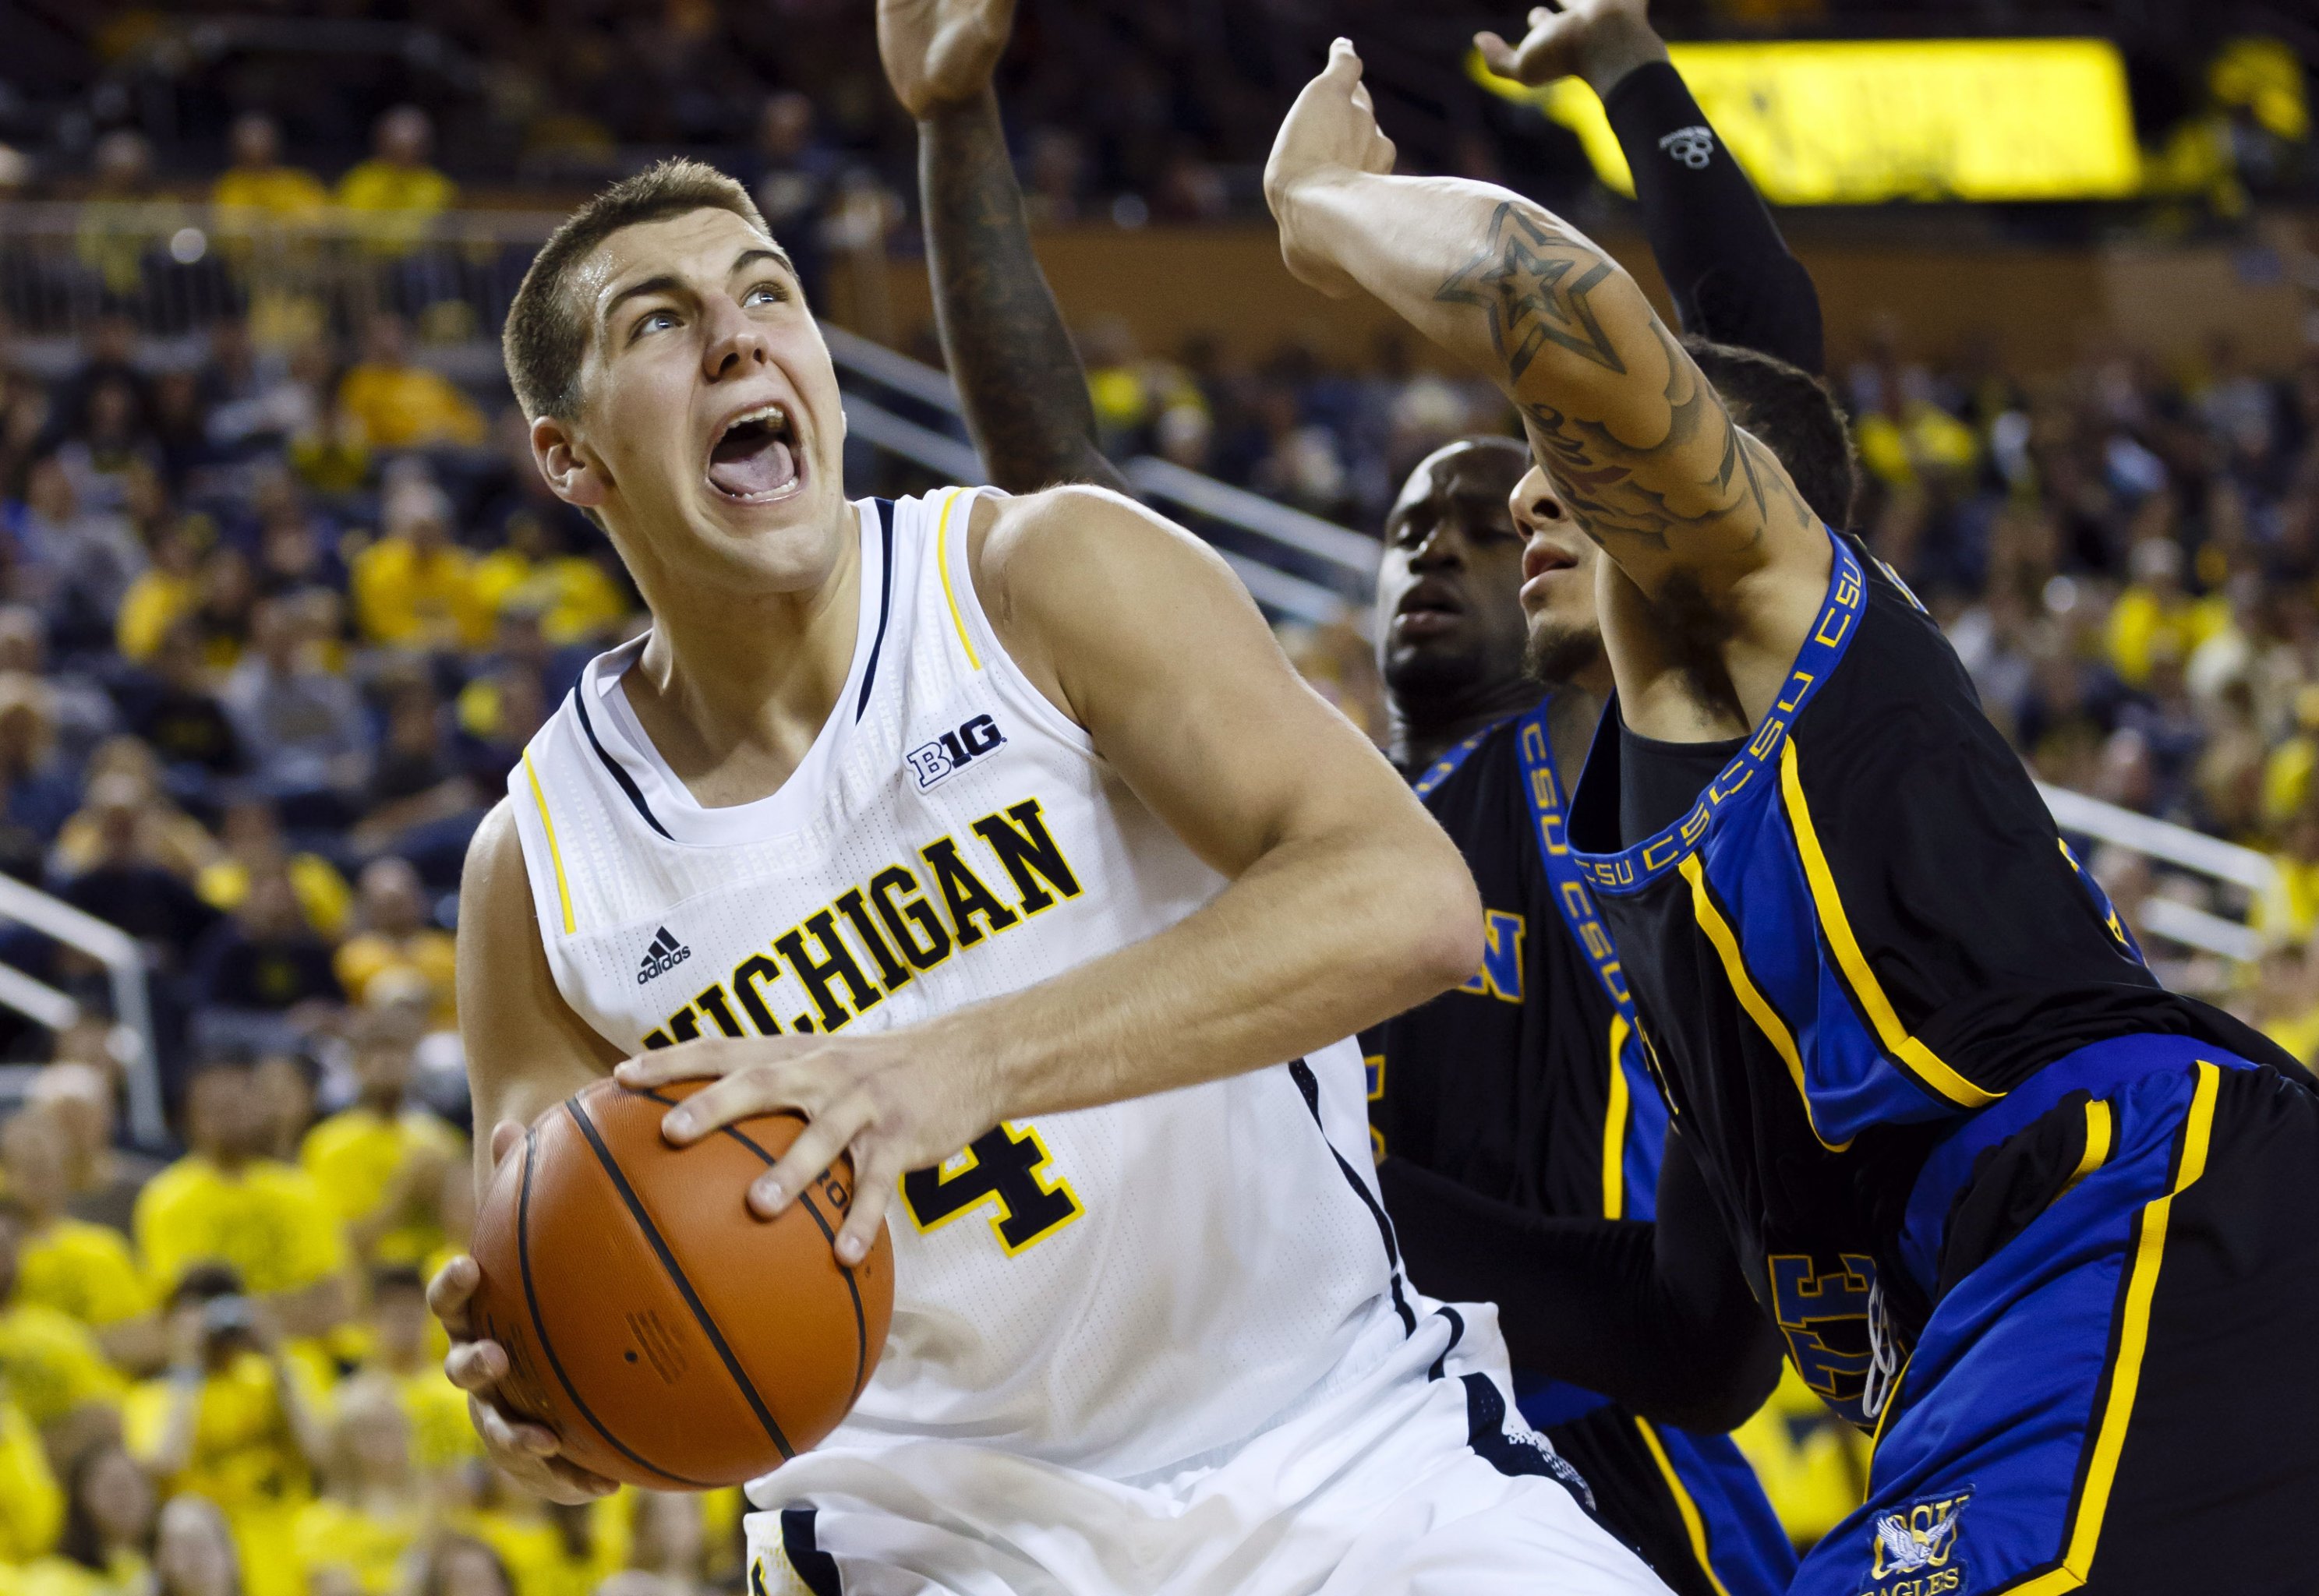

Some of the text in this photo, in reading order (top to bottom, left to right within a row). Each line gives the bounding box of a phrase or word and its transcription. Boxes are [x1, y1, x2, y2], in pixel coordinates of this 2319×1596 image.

[1815, 556, 1862, 648] CSU
[1522, 722, 1568, 855] CSU
[637, 945, 691, 985] adidas
[897, 1120, 1086, 1259] 4
[1861, 1566, 1959, 1596] GLES
